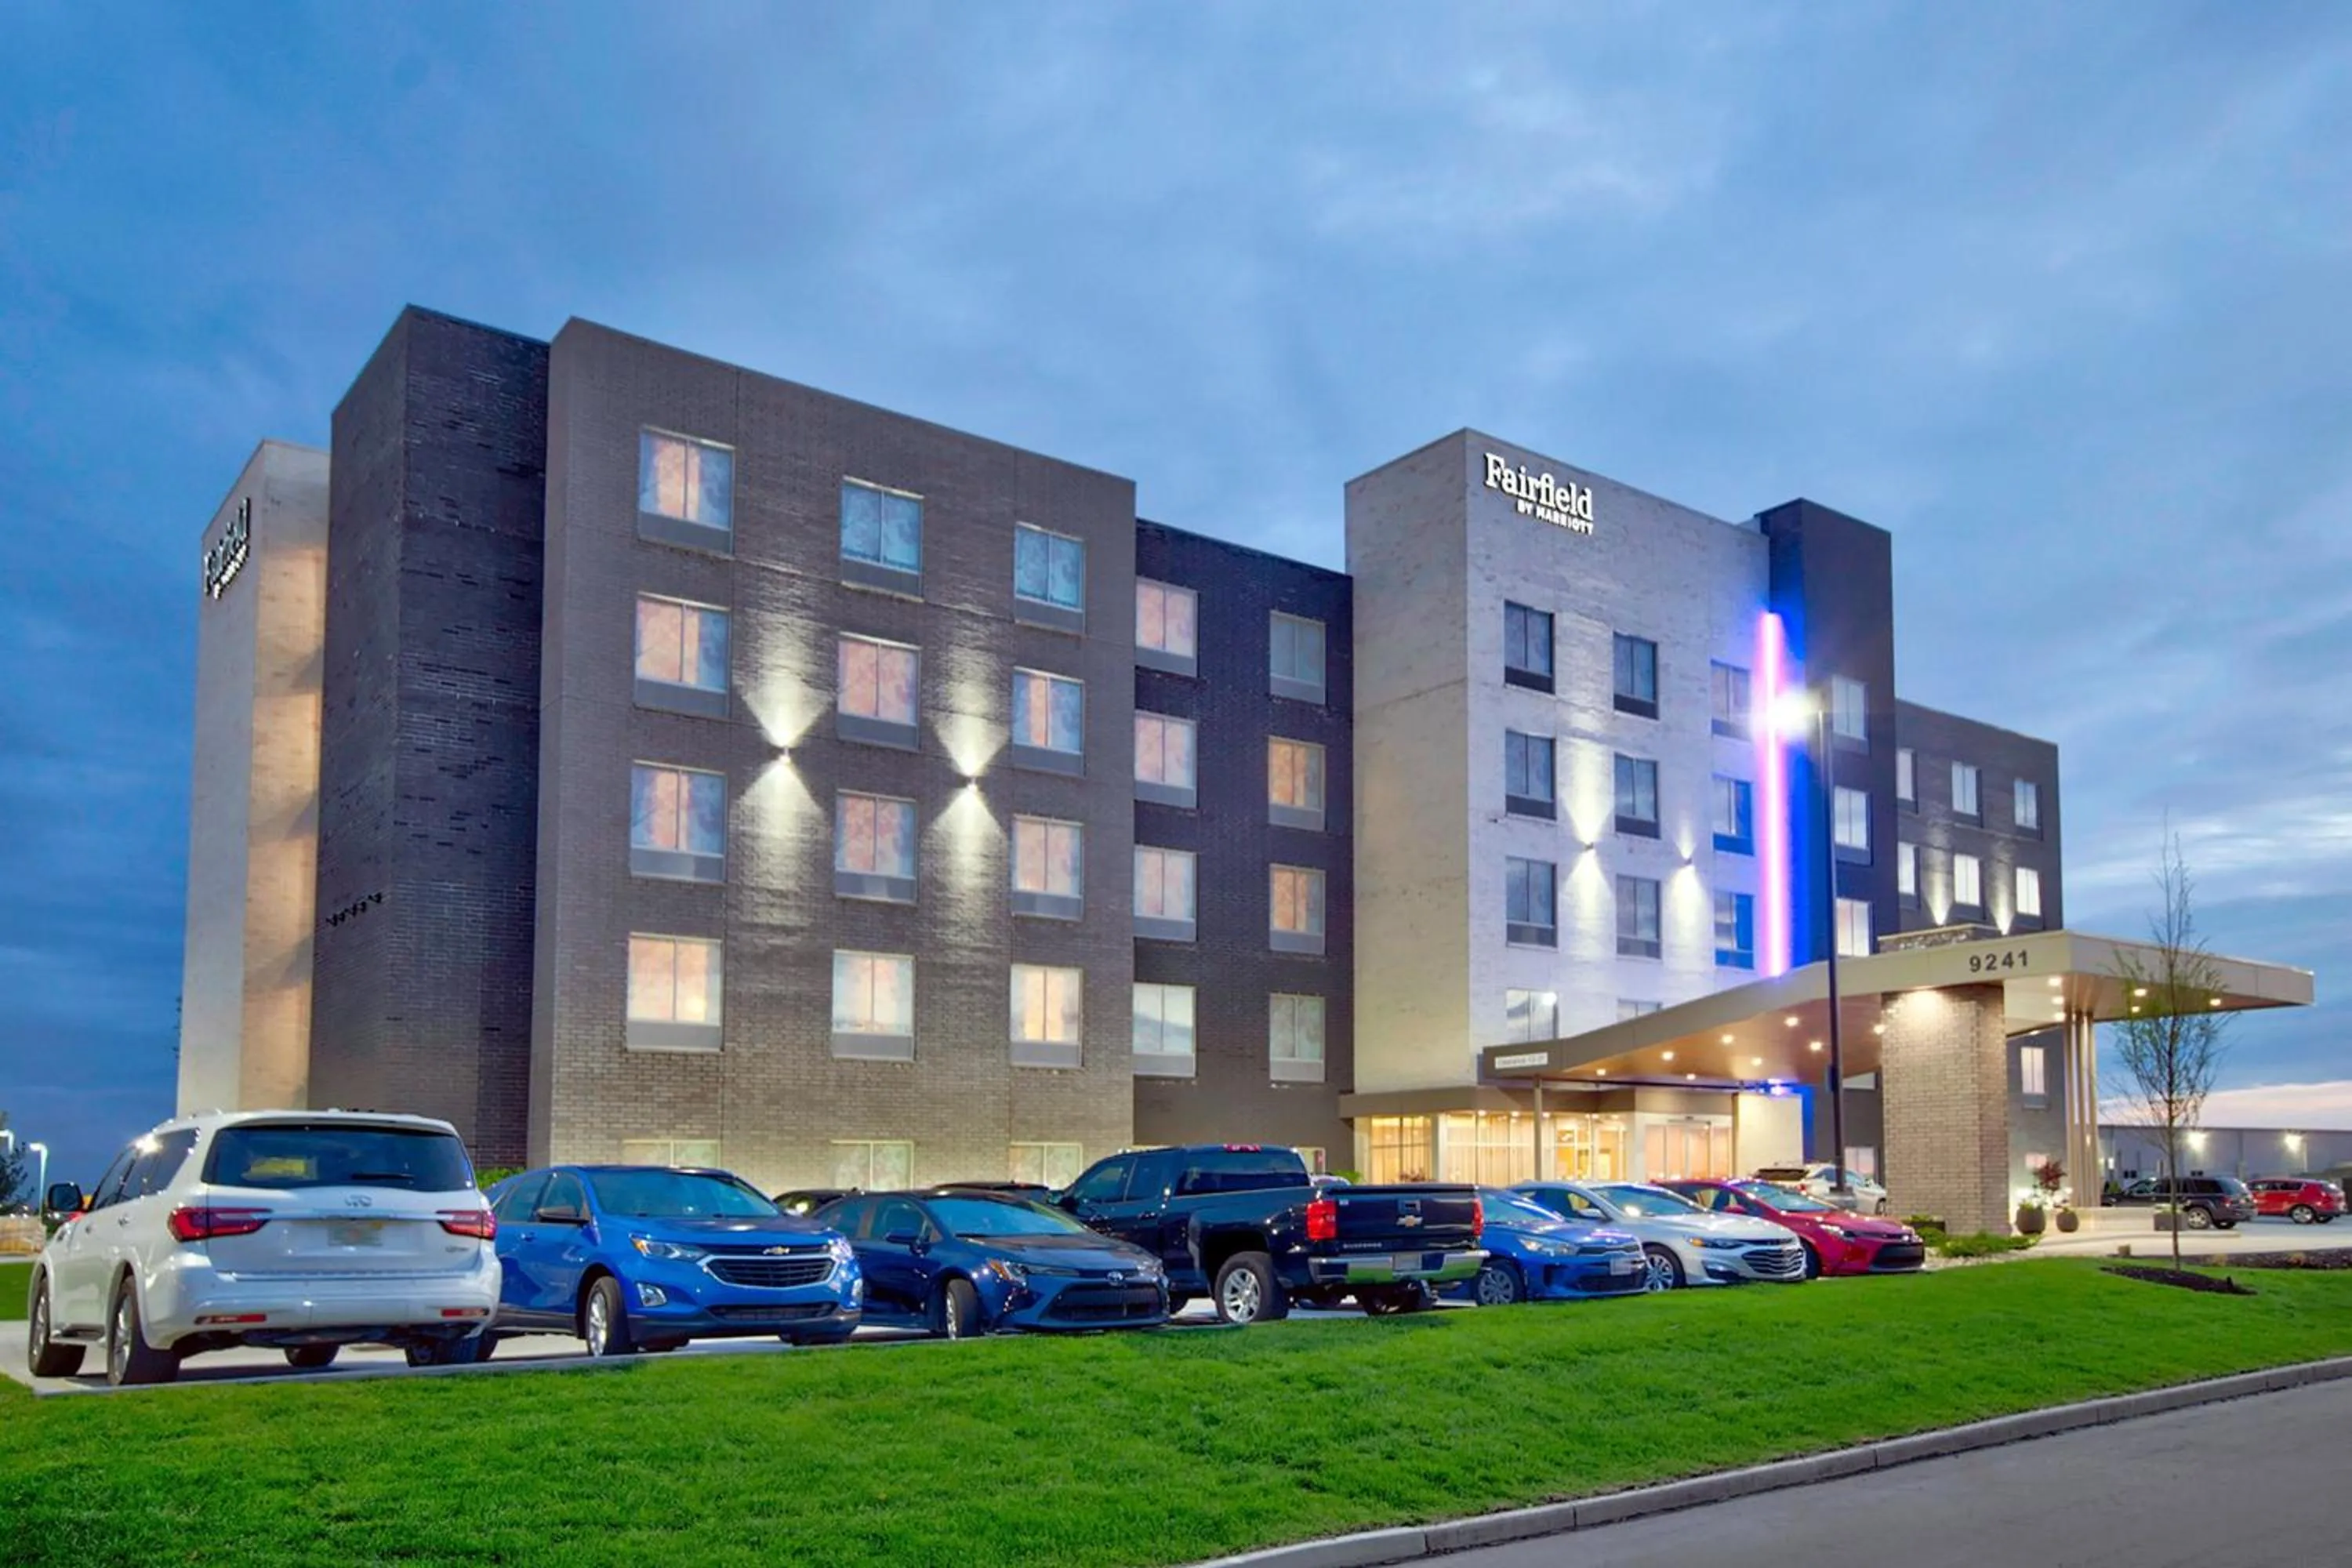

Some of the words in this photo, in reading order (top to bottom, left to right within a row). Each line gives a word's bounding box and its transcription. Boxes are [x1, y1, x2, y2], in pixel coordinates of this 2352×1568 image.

[1485, 452, 1594, 521] Fairfield
[1517, 499, 1534, 514] BY
[1969, 949, 2028, 973] 9241
